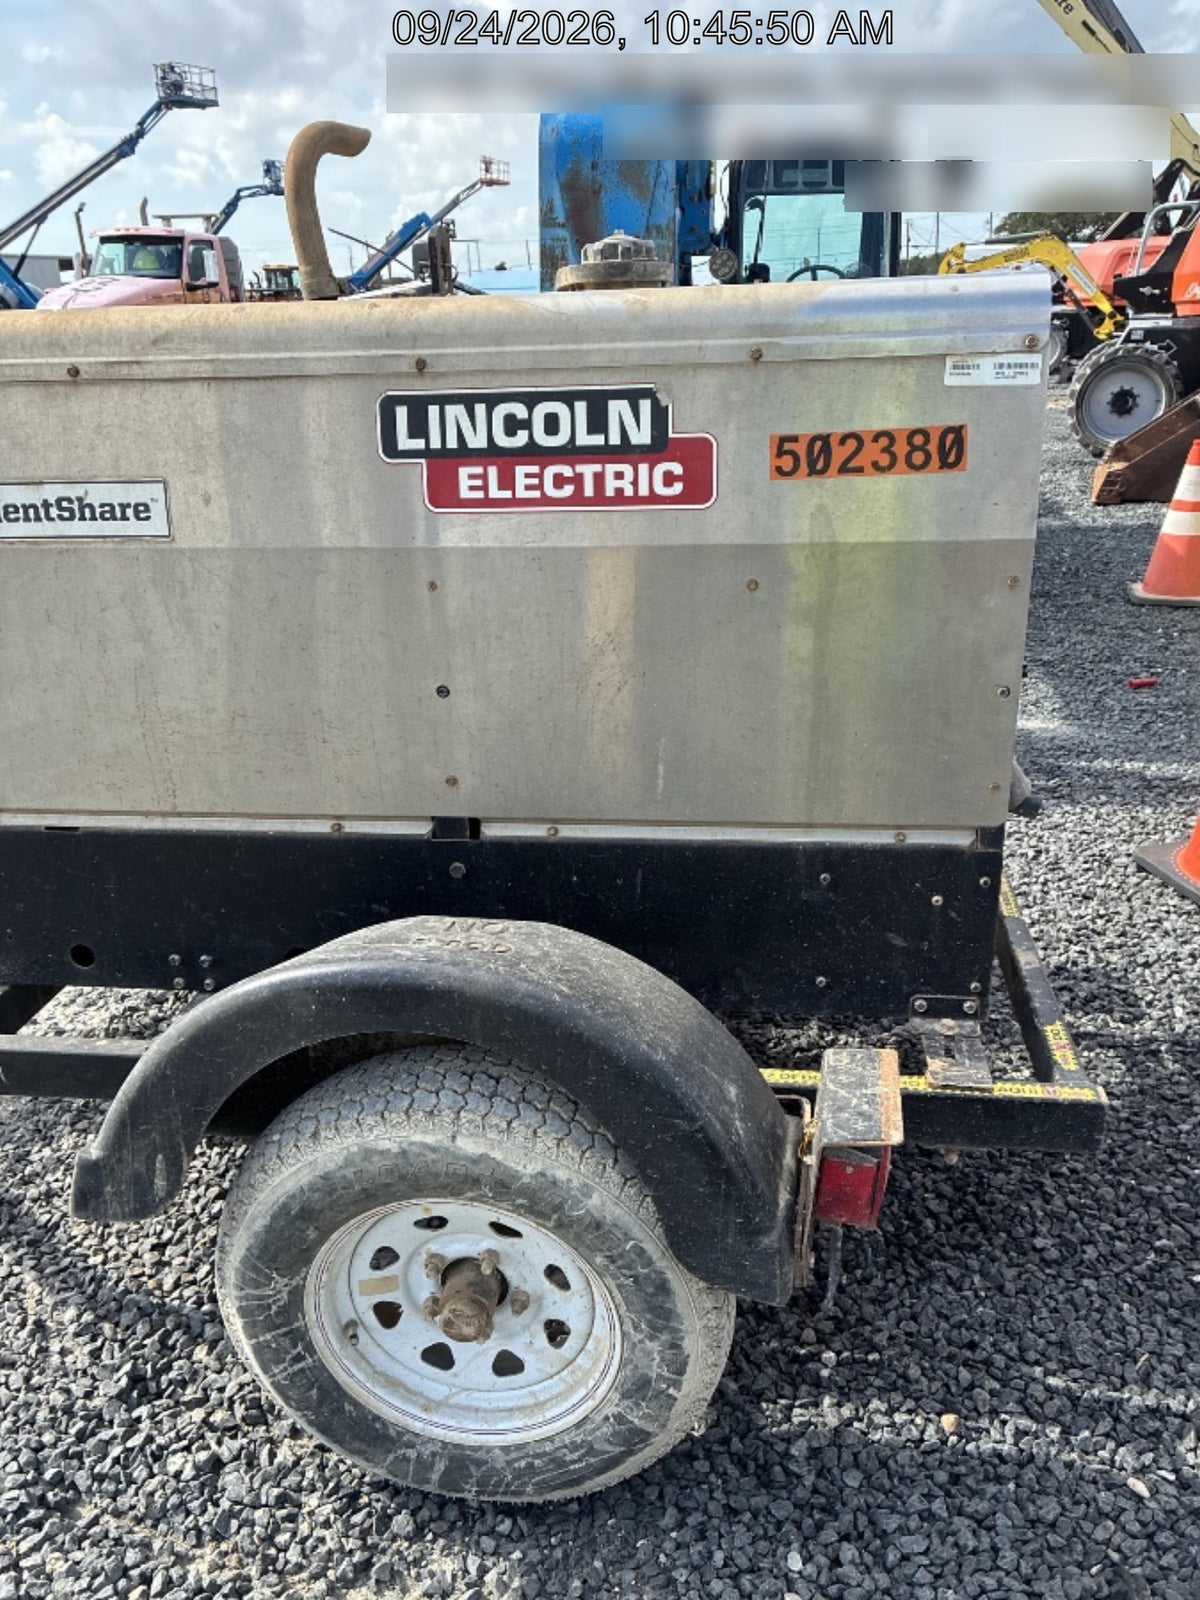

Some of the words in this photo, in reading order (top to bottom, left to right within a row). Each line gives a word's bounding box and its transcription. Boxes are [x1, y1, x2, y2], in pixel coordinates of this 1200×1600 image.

[395, 398, 652, 452] LINCOLN
[458, 461, 684, 499] ELECTRIC
[0, 495, 152, 523] entShare
